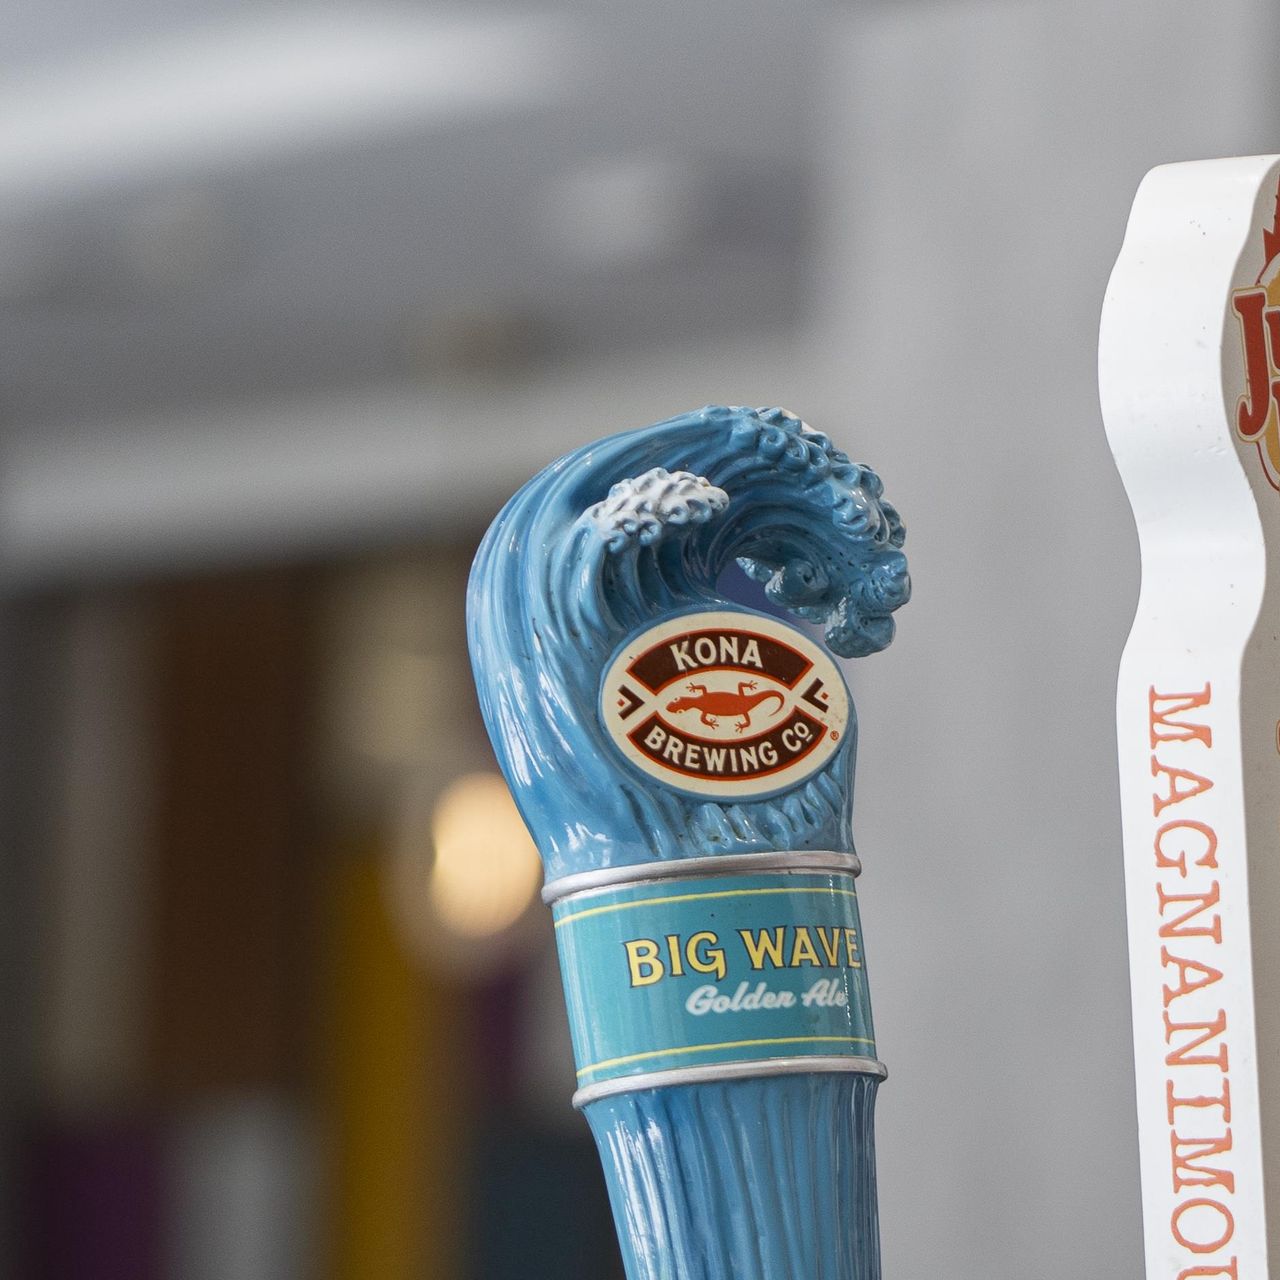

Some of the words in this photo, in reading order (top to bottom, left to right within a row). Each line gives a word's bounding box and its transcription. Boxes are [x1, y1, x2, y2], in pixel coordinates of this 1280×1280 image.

[669, 635, 764, 672] KONA
[643, 724, 779, 773] BREWING
[623, 930, 728, 989] BIG
[735, 924, 863, 971] WAVE
[684, 980, 797, 1017] Golden
[800, 977, 849, 1009] Ale
